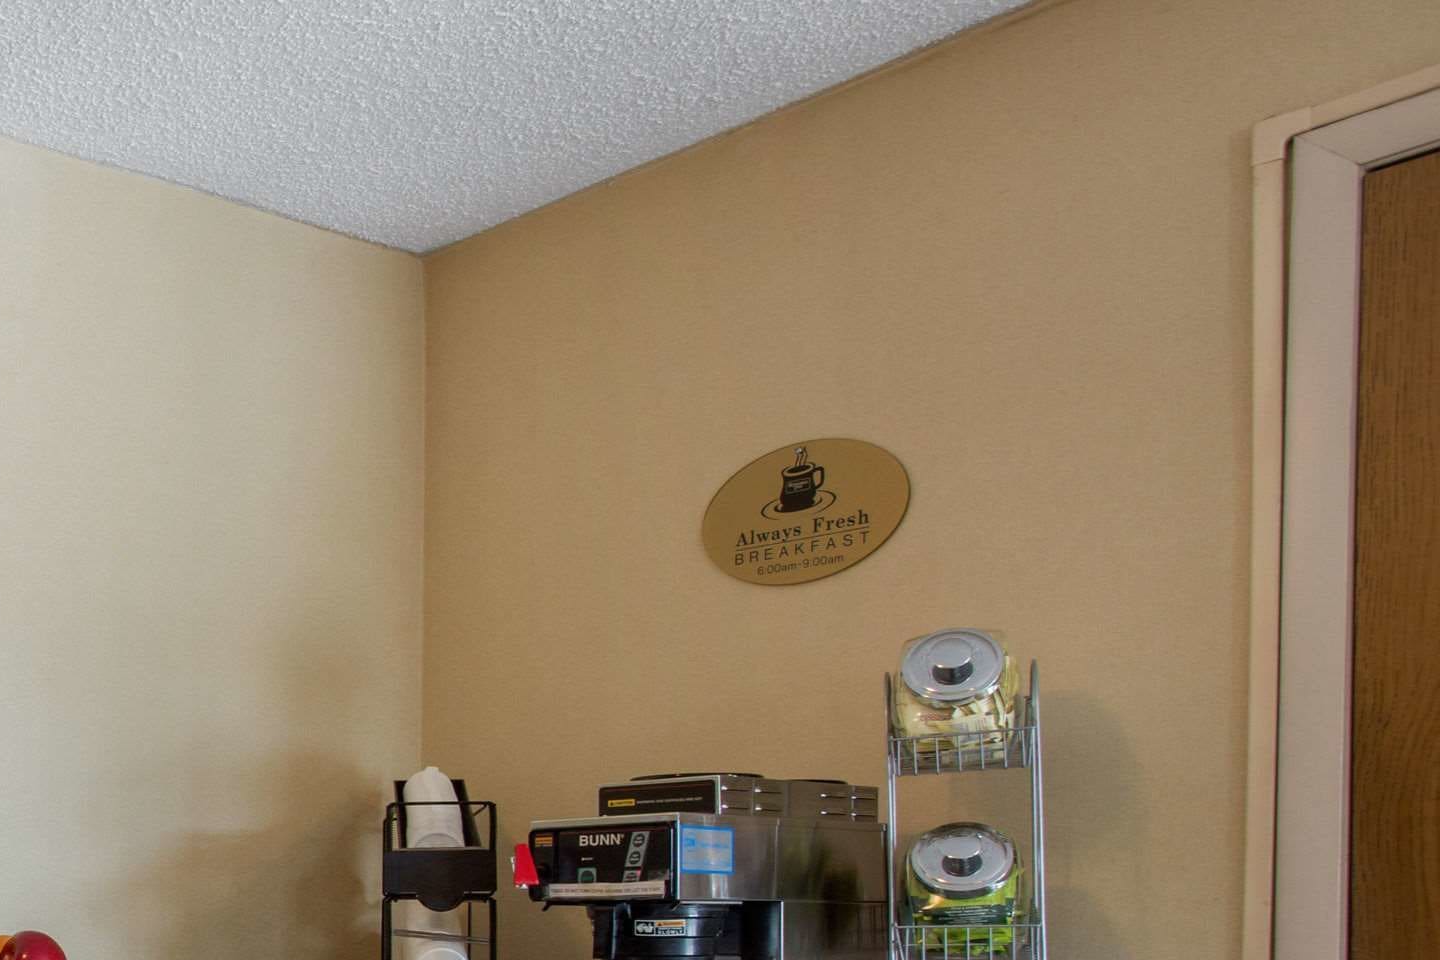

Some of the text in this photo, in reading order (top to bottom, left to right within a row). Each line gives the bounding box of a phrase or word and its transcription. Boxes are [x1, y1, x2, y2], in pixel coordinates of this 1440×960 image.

[736, 509, 870, 547] Always Fresh
[734, 531, 871, 566] BREAKFAST
[578, 833, 622, 847] BUNN
